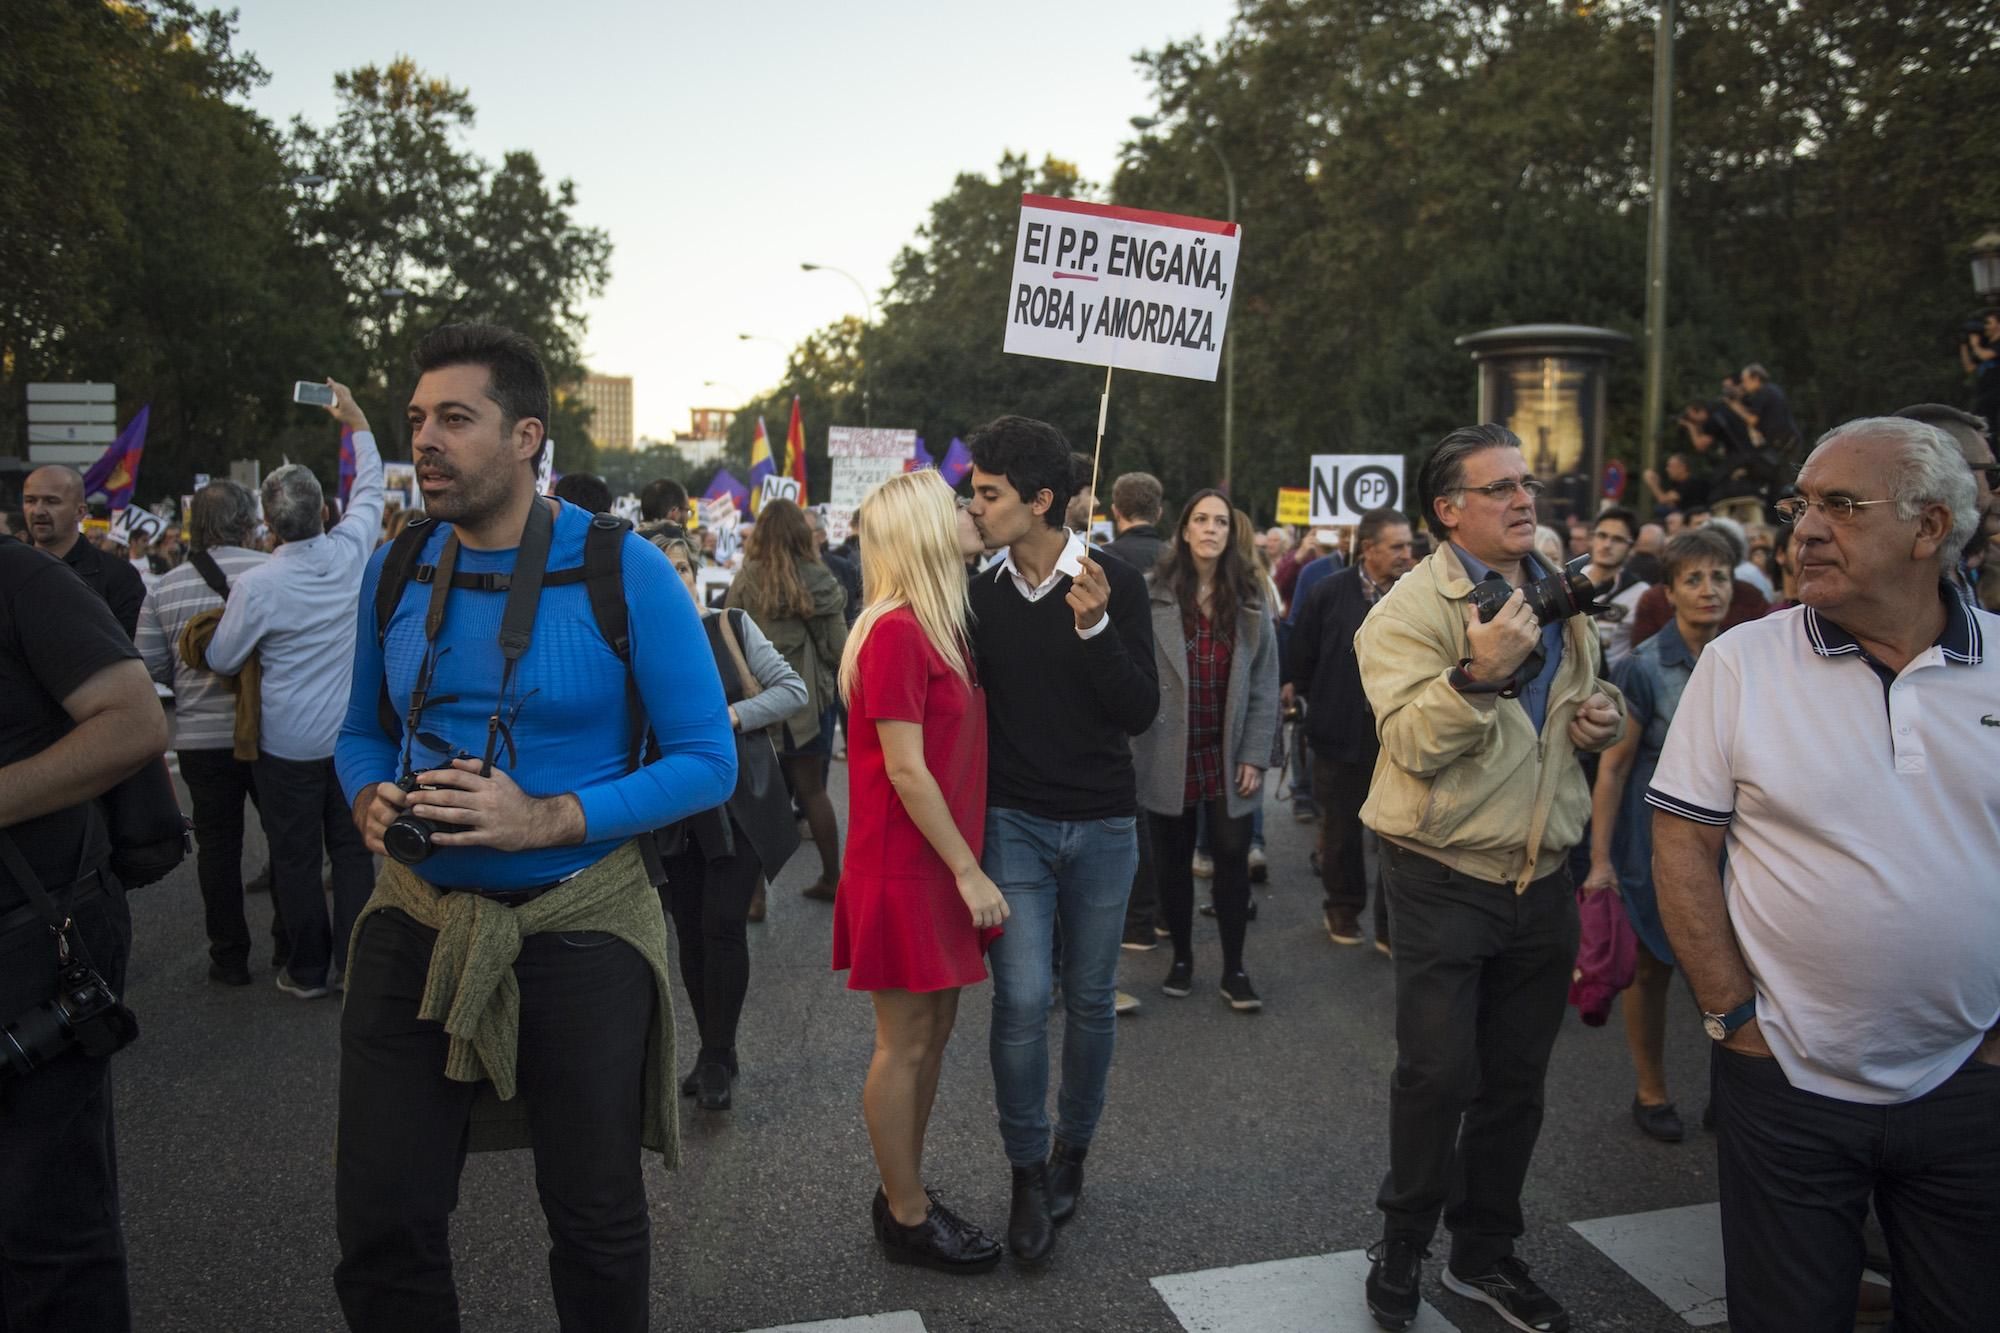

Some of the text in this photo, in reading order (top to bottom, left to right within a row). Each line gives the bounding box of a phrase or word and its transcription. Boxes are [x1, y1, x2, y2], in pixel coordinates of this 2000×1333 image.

[1056, 226, 1099, 272] P.P.
[1107, 234, 1227, 300] ENGAÑA,
[1014, 283, 1216, 352] ROBA y AMORDAZA.
[763, 478, 798, 501] NO
[1313, 465, 1399, 517] NO
[1359, 479, 1386, 502] PP
[115, 507, 160, 540] NO
